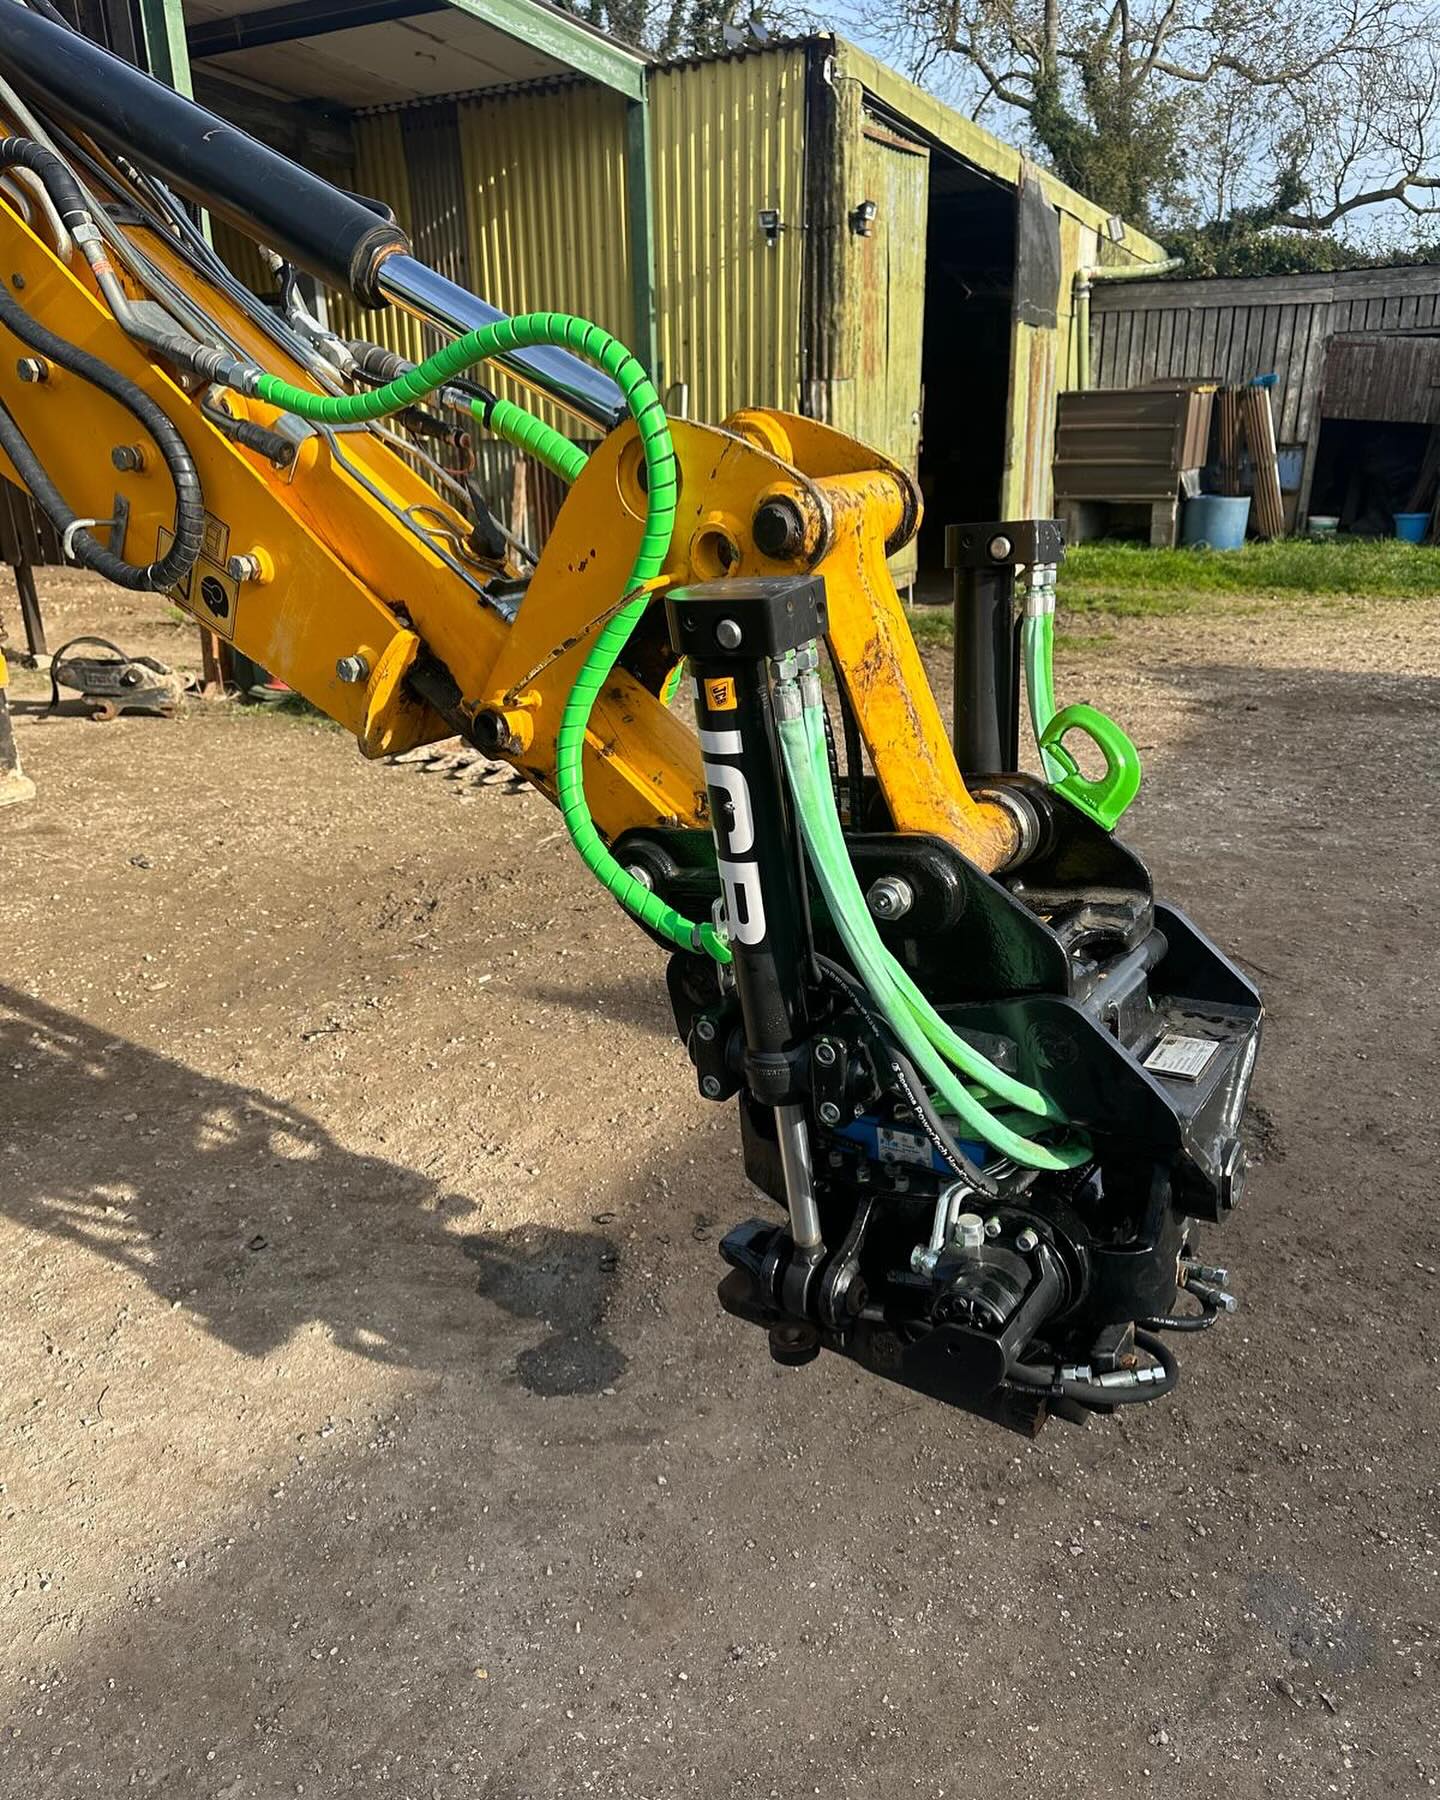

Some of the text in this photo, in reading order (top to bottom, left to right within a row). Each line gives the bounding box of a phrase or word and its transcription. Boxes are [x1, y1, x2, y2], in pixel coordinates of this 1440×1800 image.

[712, 686, 727, 704] JCB
[695, 677, 767, 945] JCB
[898, 1071, 917, 1106] Specma
[914, 1105, 948, 1156] PowerTech
